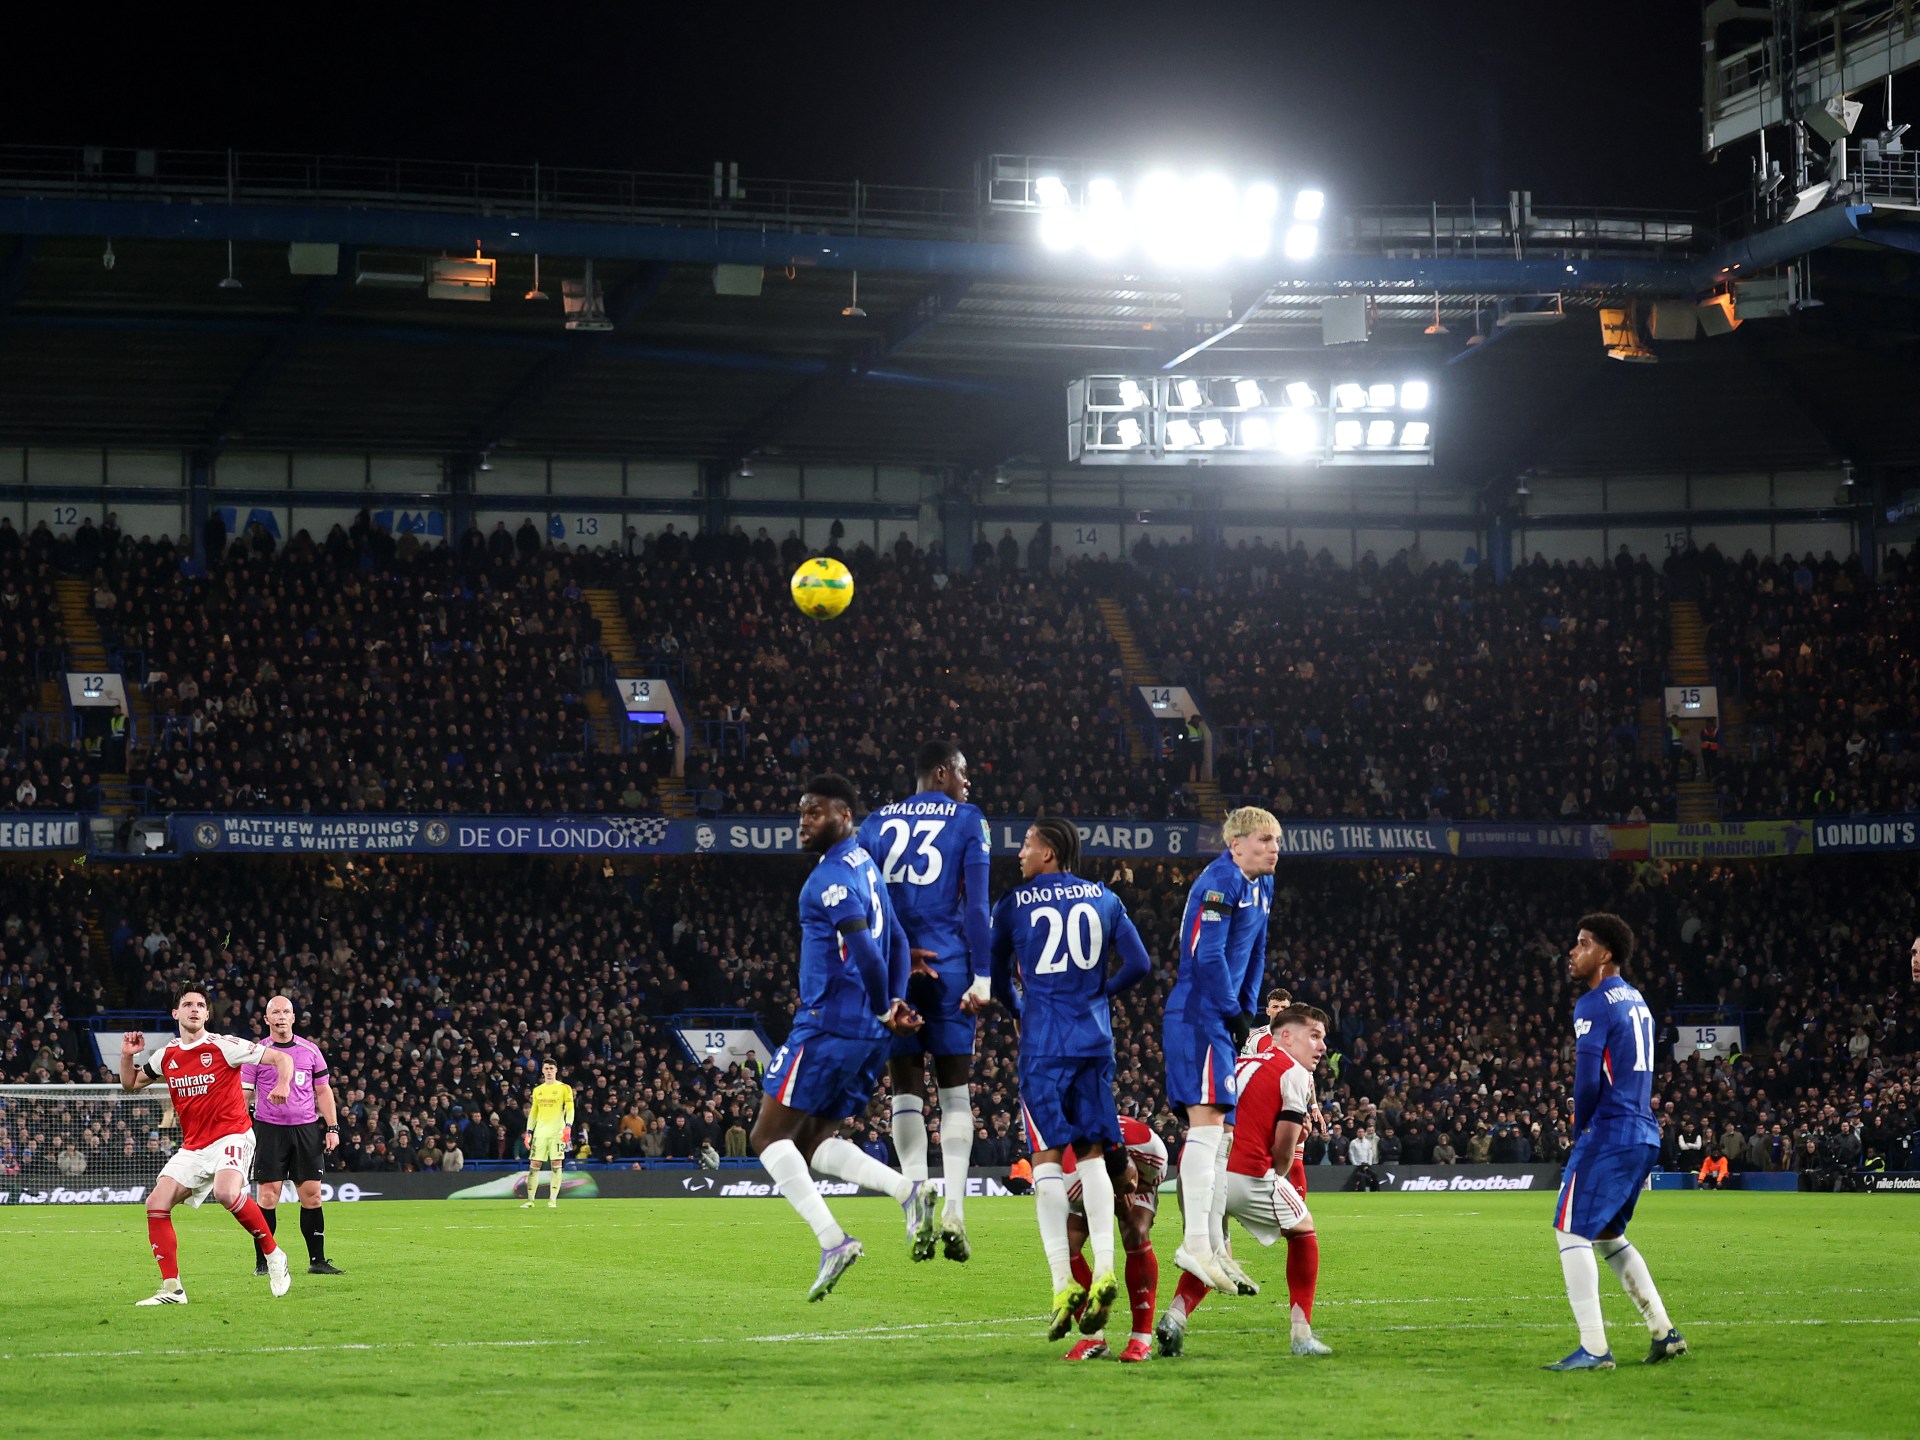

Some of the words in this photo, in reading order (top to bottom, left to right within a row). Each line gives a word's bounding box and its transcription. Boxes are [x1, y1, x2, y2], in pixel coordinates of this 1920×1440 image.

[54, 507, 77, 525] 12
[576, 517, 598, 535] 13
[1075, 528, 1097, 545] 14
[1664, 533, 1686, 549] 15
[84, 676, 104, 691] 12
[630, 681, 650, 696] 13
[1151, 689, 1171, 703] 14
[1681, 689, 1700, 703] 15
[880, 802, 957, 817] CHALOBAH
[0, 822, 79, 847] EGEND
[224, 819, 313, 834] MATTHEW
[321, 821, 419, 835] HARDING'S
[1721, 822, 1745, 835] THE
[1817, 822, 1915, 848] LONDON'S
[229, 833, 274, 846] BLUE
[282, 835, 293, 847] &
[300, 837, 359, 849] WHITE
[365, 835, 415, 848] ARMY
[459, 828, 490, 847] DE
[497, 828, 531, 848] OF
[1004, 825, 1154, 850] LPARD
[1168, 831, 1182, 854] 8
[1279, 828, 1335, 851] AKING
[1340, 827, 1374, 848] THE
[1379, 828, 1436, 850] MIKEL
[880, 818, 946, 886] 23
[1655, 842, 1699, 856] LITTLE
[1703, 840, 1777, 856] MAGICIAN
[1015, 887, 1052, 908] JOÃO
[1055, 884, 1103, 900] PEDRO
[1030, 902, 1103, 975] 20
[705, 1032, 726, 1048] 13
[1628, 1005, 1655, 1072] 17
[1696, 1028, 1717, 1043] 15
[770, 1045, 789, 1073] 5
[169, 1073, 215, 1089] Emirates
[225, 1146, 242, 1160] 41
[720, 1181, 771, 1196] nike
[772, 1180, 859, 1196] ftball
[1401, 1176, 1447, 1191] nike
[1450, 1175, 1534, 1190] football
[1876, 1178, 1893, 1189] nike
[1894, 1177, 1920, 1189] footba
